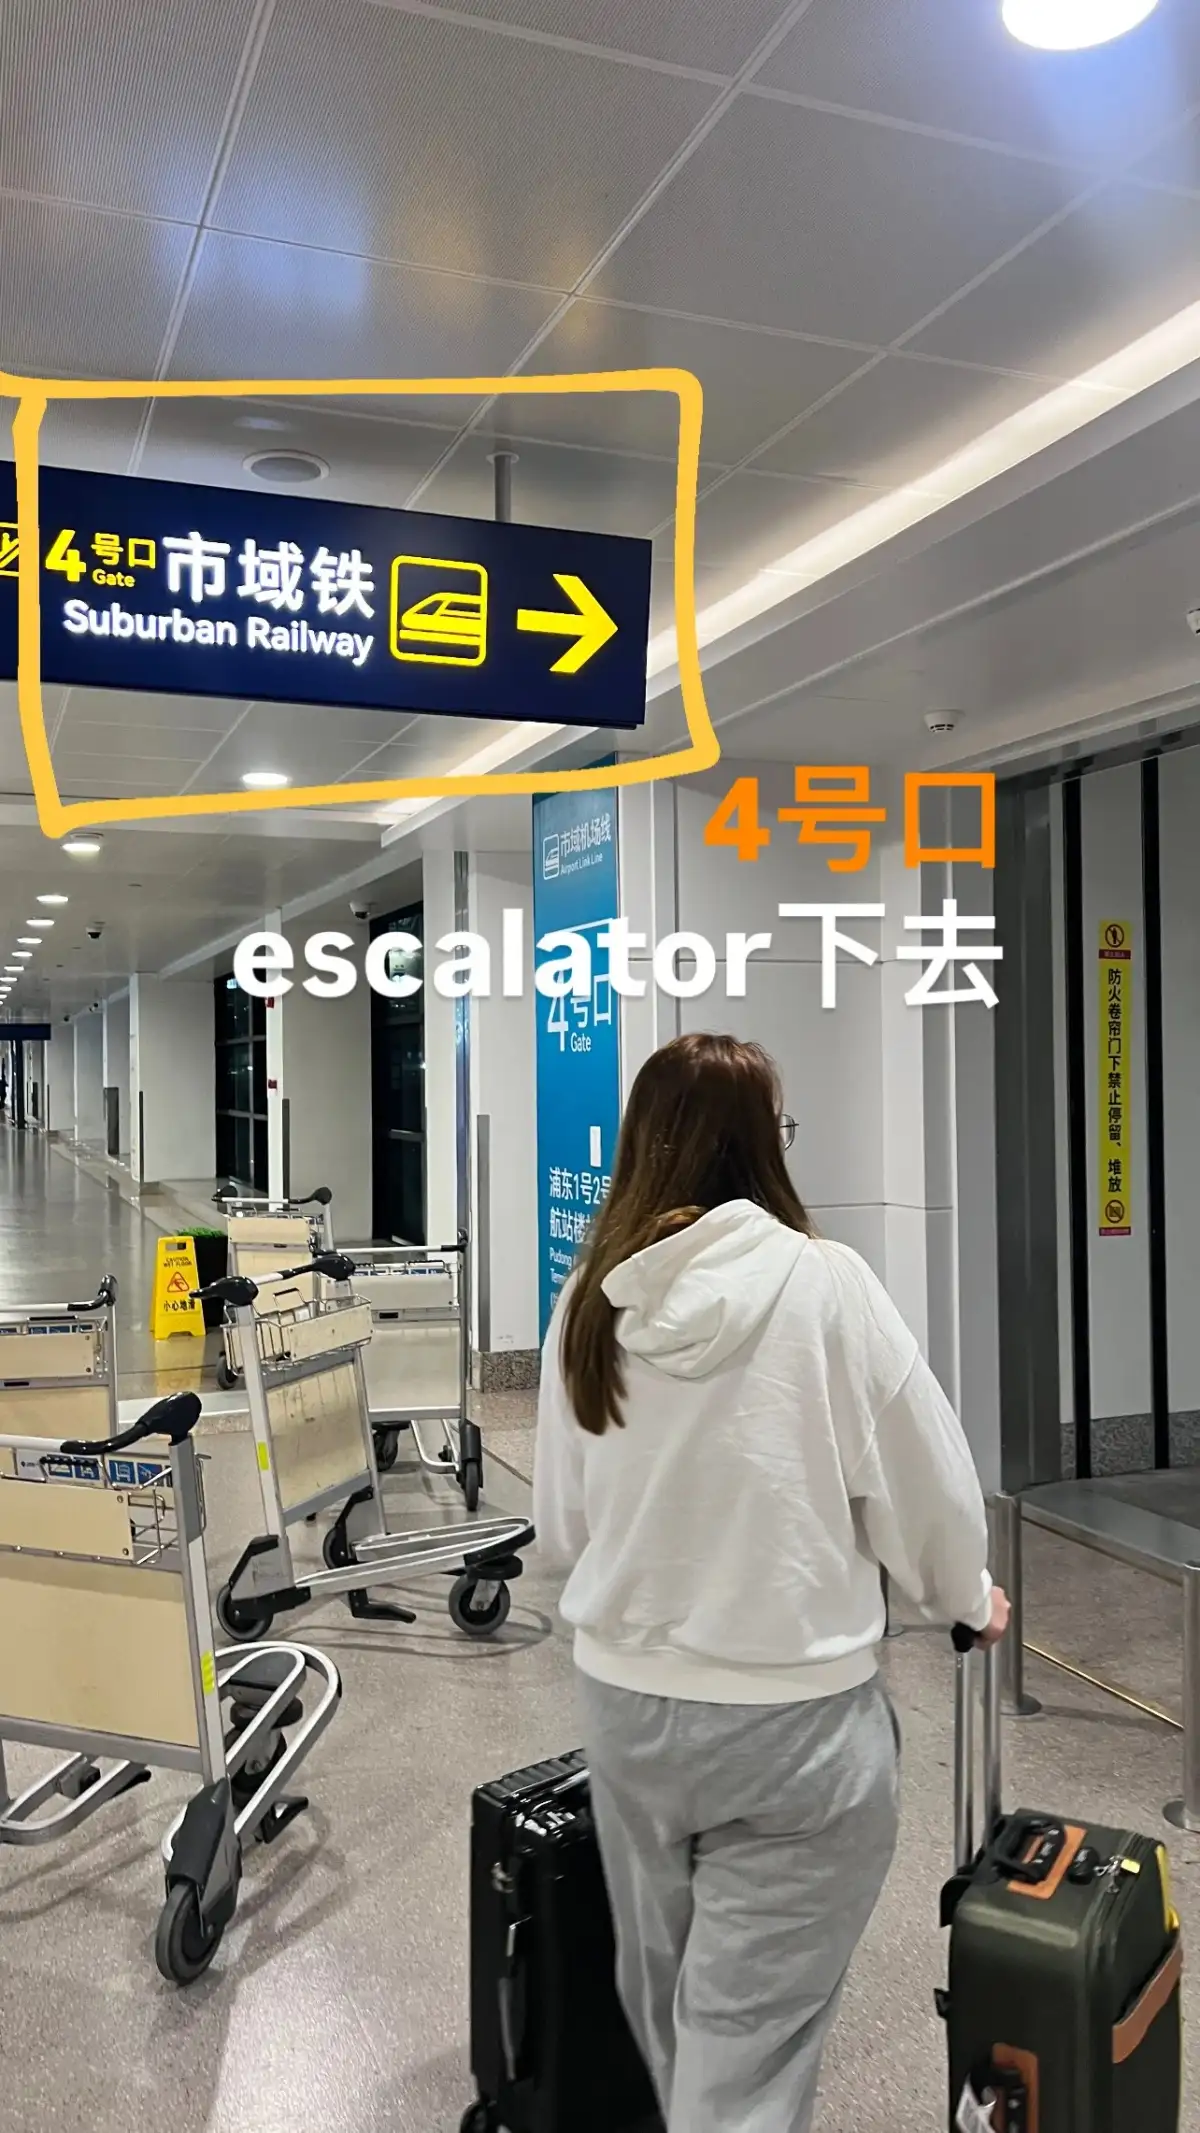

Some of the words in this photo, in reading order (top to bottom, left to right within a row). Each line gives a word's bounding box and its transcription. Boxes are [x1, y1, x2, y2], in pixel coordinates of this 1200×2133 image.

[45, 528, 156, 583] 4号口
[162, 531, 376, 619] 市域铁
[91, 568, 136, 588] Gate
[63, 599, 238, 647] Suburban
[247, 618, 374, 667] Railway
[560, 813, 611, 857] 市域机场线
[560, 858, 579, 876] Airport
[579, 853, 591, 869] Link
[570, 1031, 592, 1052] Gate
[549, 1246, 573, 1270] Pudong
